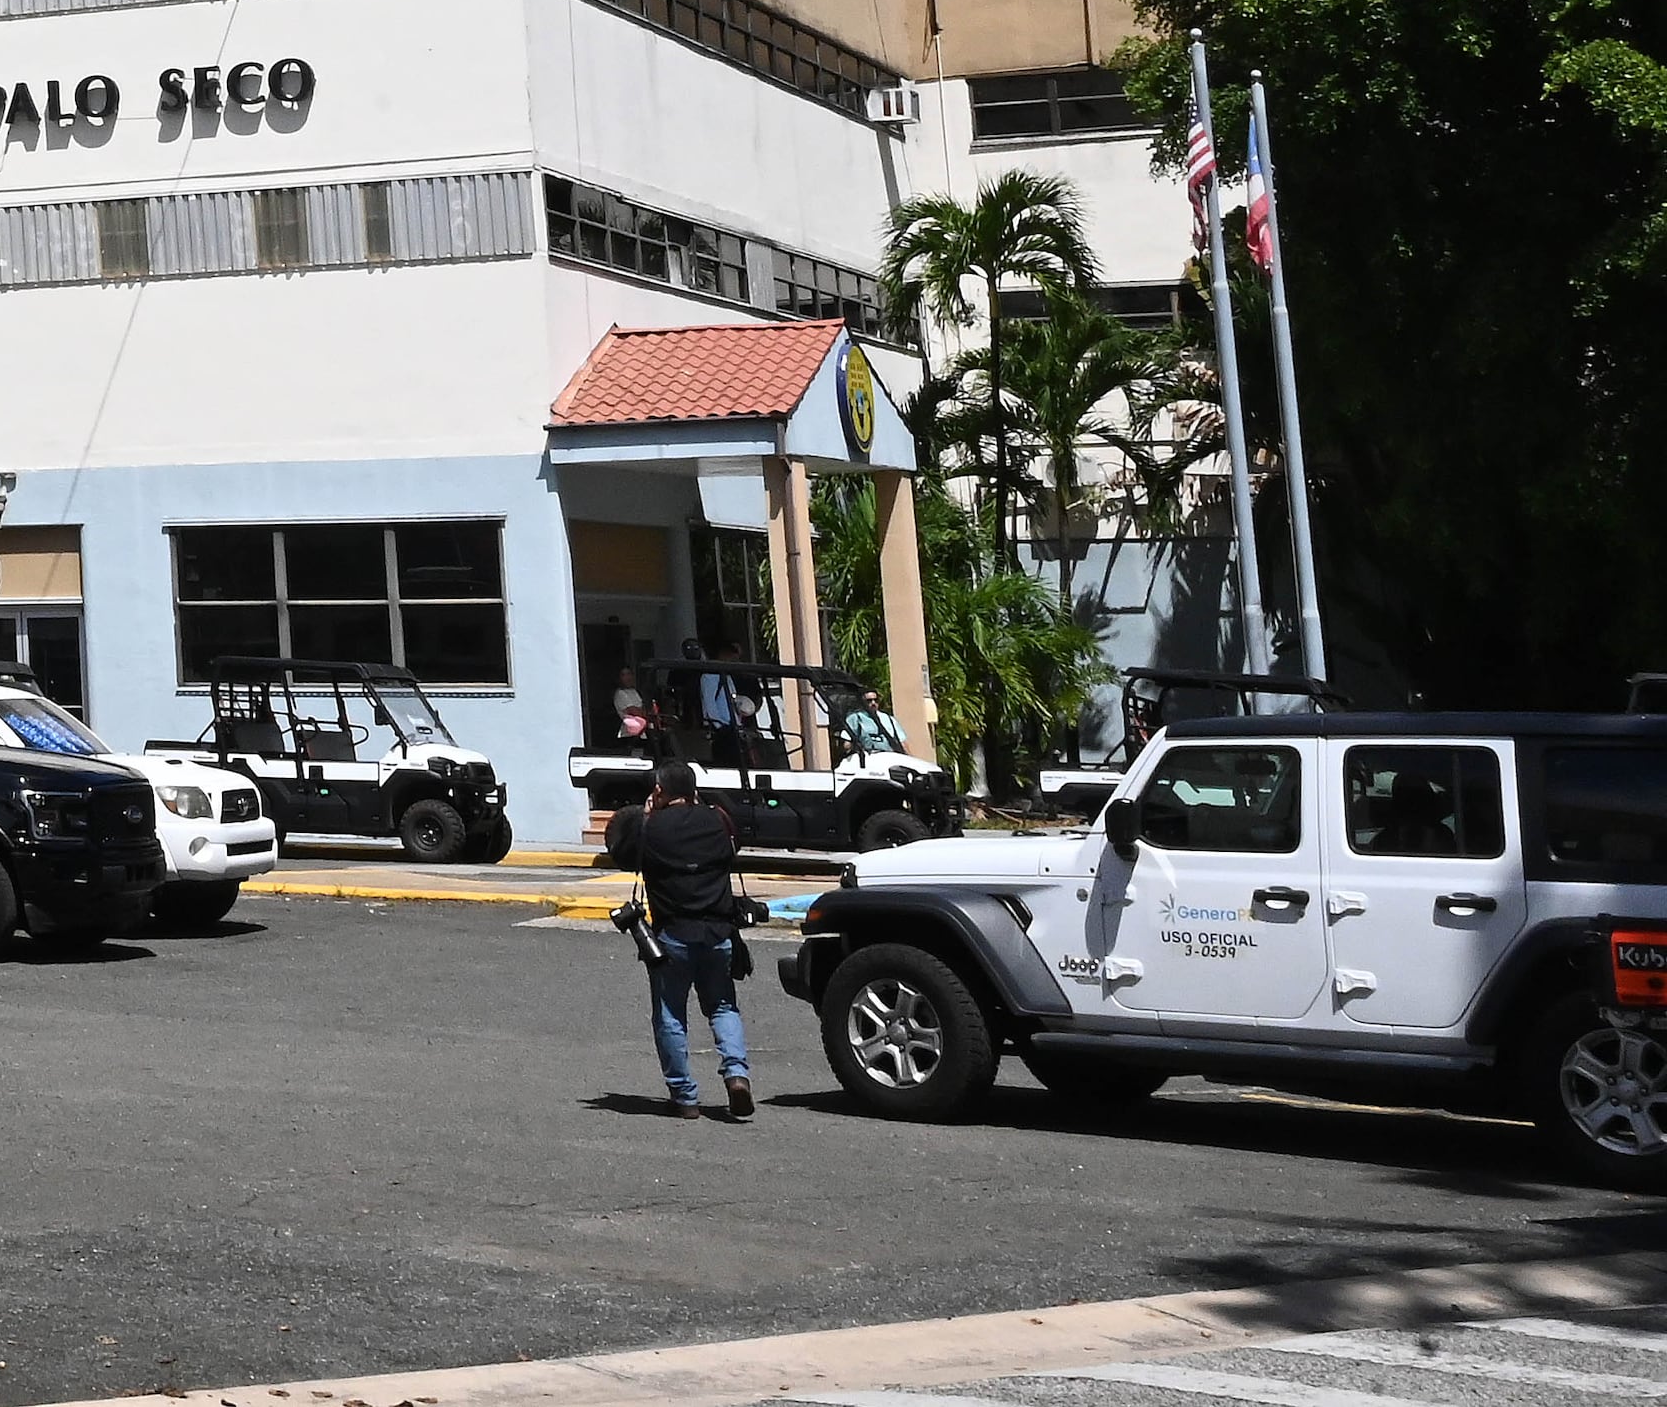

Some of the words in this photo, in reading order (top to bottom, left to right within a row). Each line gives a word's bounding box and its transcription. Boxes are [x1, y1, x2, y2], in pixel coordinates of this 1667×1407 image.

[159, 58, 316, 111] SECO
[1161, 930, 1193, 944] USO
[1197, 932, 1258, 947] OFICIAL
[1184, 944, 1236, 958] 3-0539
[1618, 946, 1667, 968] Kub
